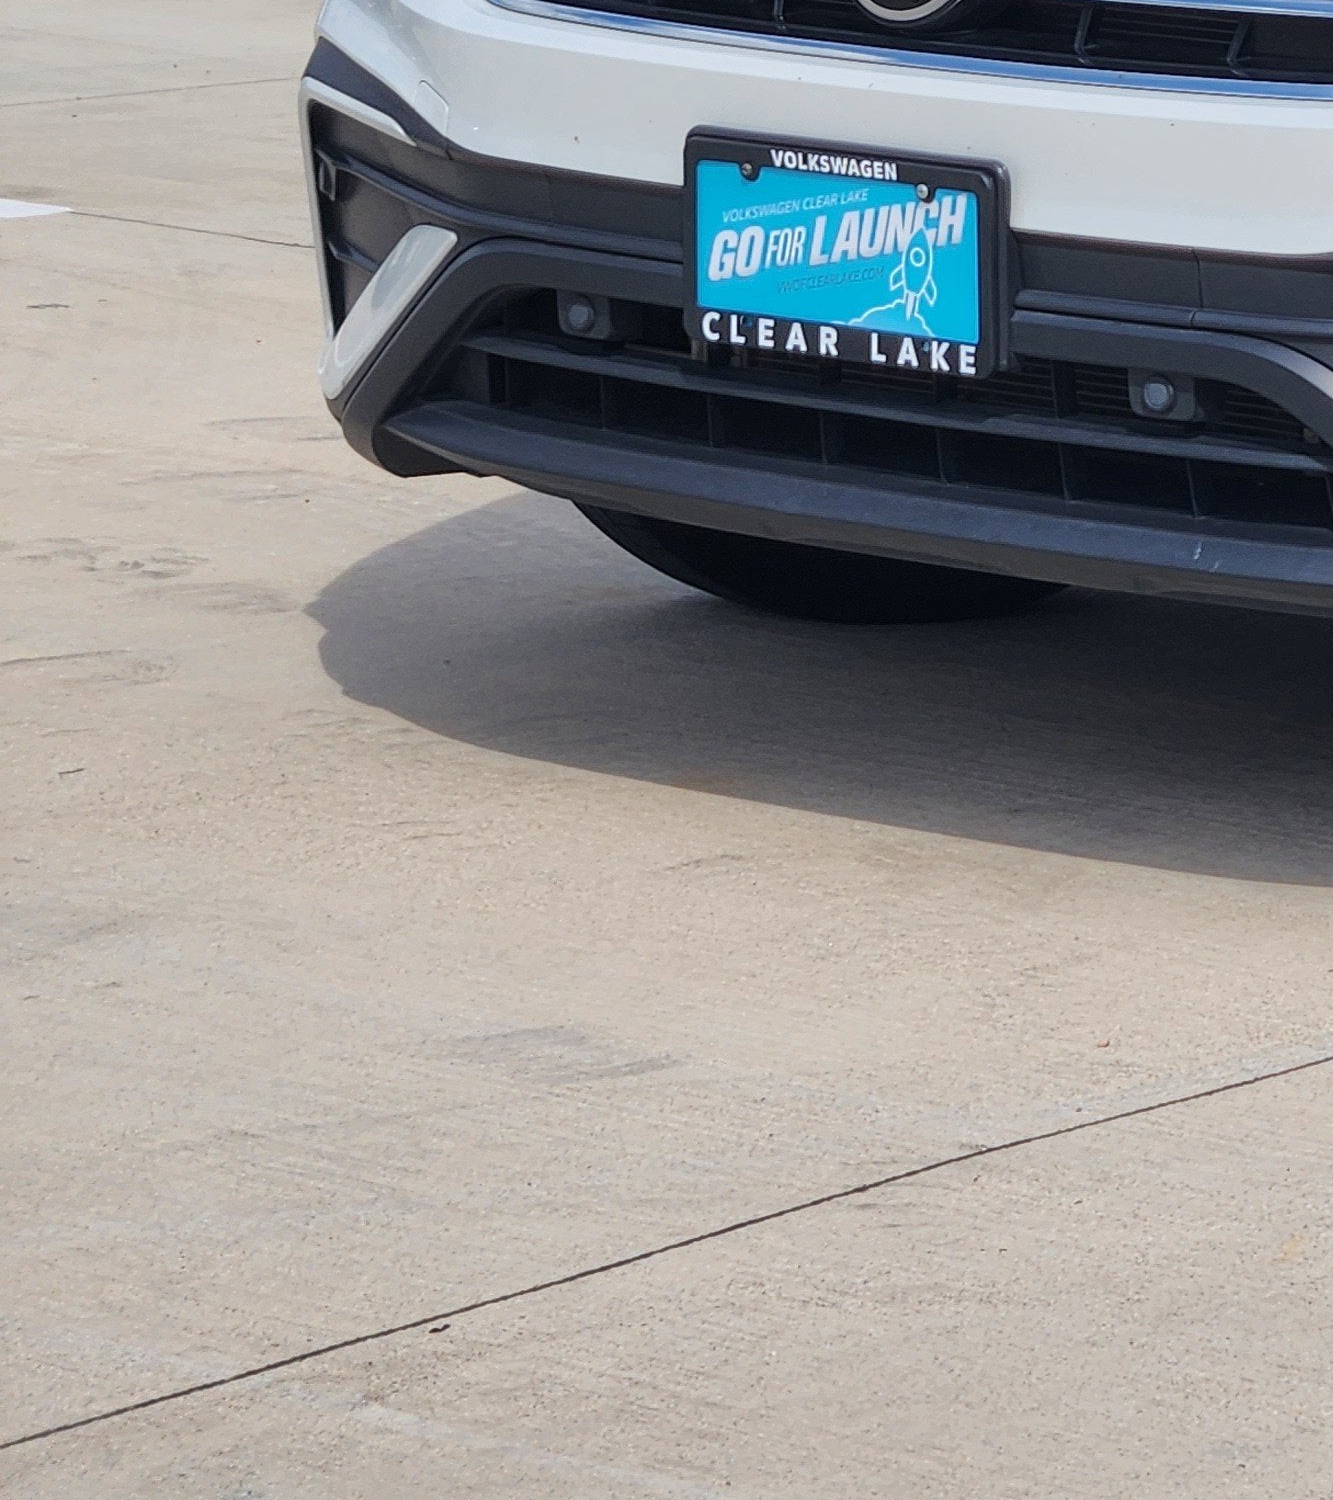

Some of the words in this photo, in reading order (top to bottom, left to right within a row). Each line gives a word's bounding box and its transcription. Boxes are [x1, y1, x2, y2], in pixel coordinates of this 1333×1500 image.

[770, 149, 898, 181] VOLKSWAGEN
[722, 199, 800, 223] VOLKSWAGEN
[802, 193, 839, 211] CLEAR
[840, 188, 869, 205] LAKE
[708, 225, 766, 282] GO
[764, 225, 807, 270] FOR
[808, 194, 968, 267] LAUNCH
[701, 311, 840, 357] CLEAR
[869, 332, 978, 376] LAKE
